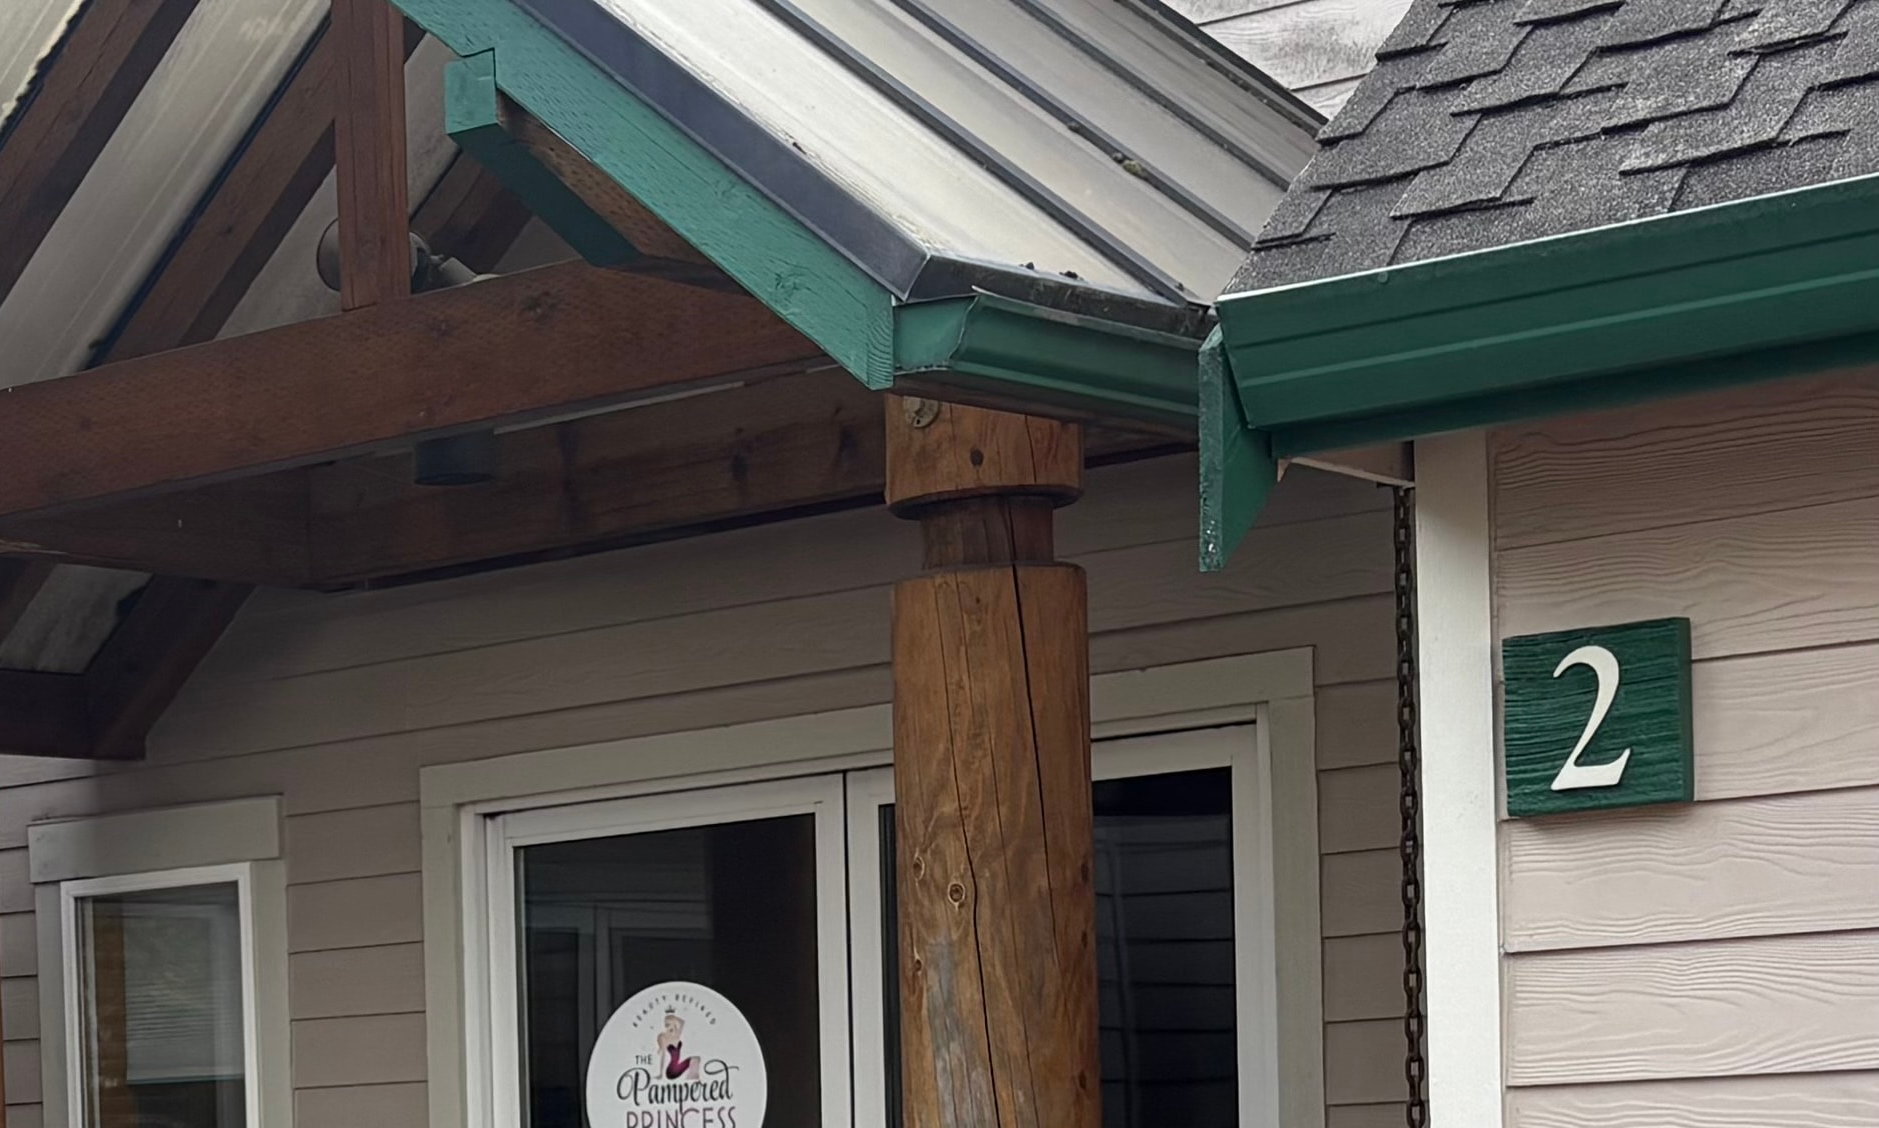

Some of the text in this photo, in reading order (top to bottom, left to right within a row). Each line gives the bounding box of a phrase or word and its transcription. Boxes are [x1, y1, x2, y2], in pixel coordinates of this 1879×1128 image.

[1550, 644, 1631, 791] 2
[617, 1059, 739, 1114] Pampered
[635, 1054, 653, 1066] THE
